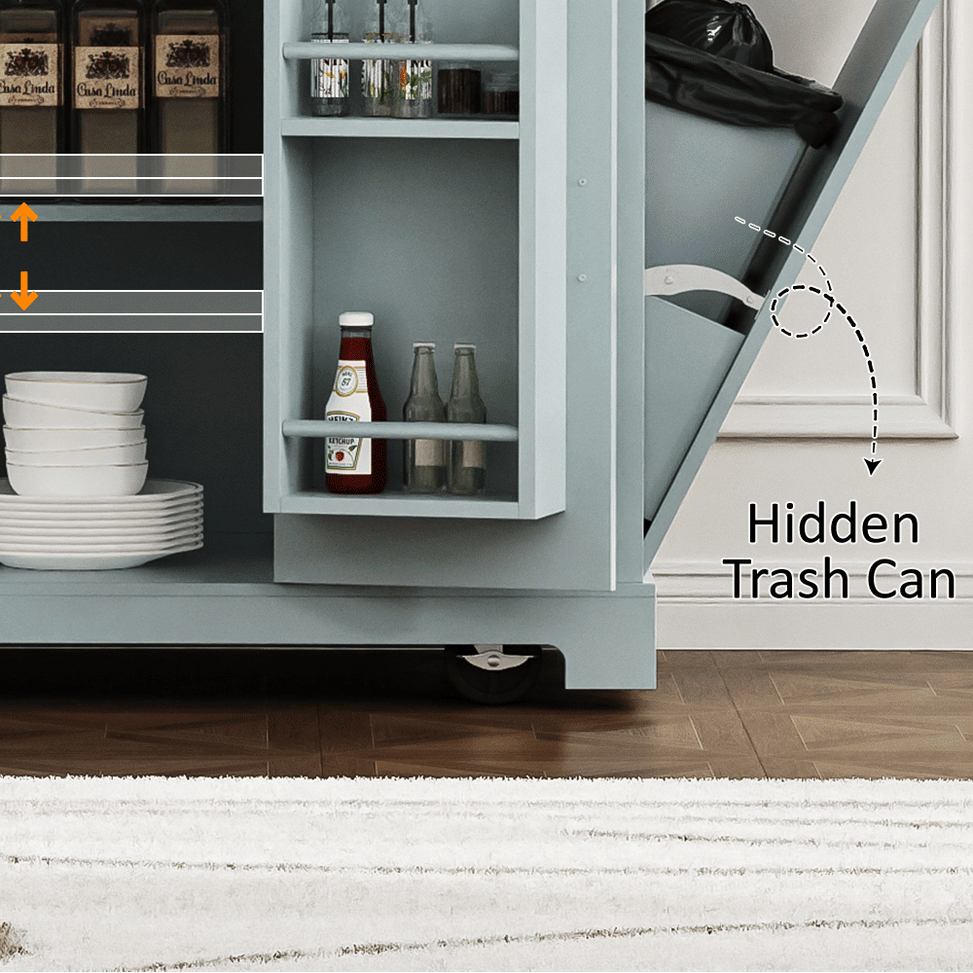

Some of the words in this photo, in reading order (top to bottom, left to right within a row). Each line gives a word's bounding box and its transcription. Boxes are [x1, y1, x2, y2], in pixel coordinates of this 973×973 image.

[157, 71, 183, 85] Casa
[184, 71, 217, 86] Linda
[22, 80, 55, 95] Linda
[77, 82, 103, 97] Casa
[104, 83, 137, 98] Linda
